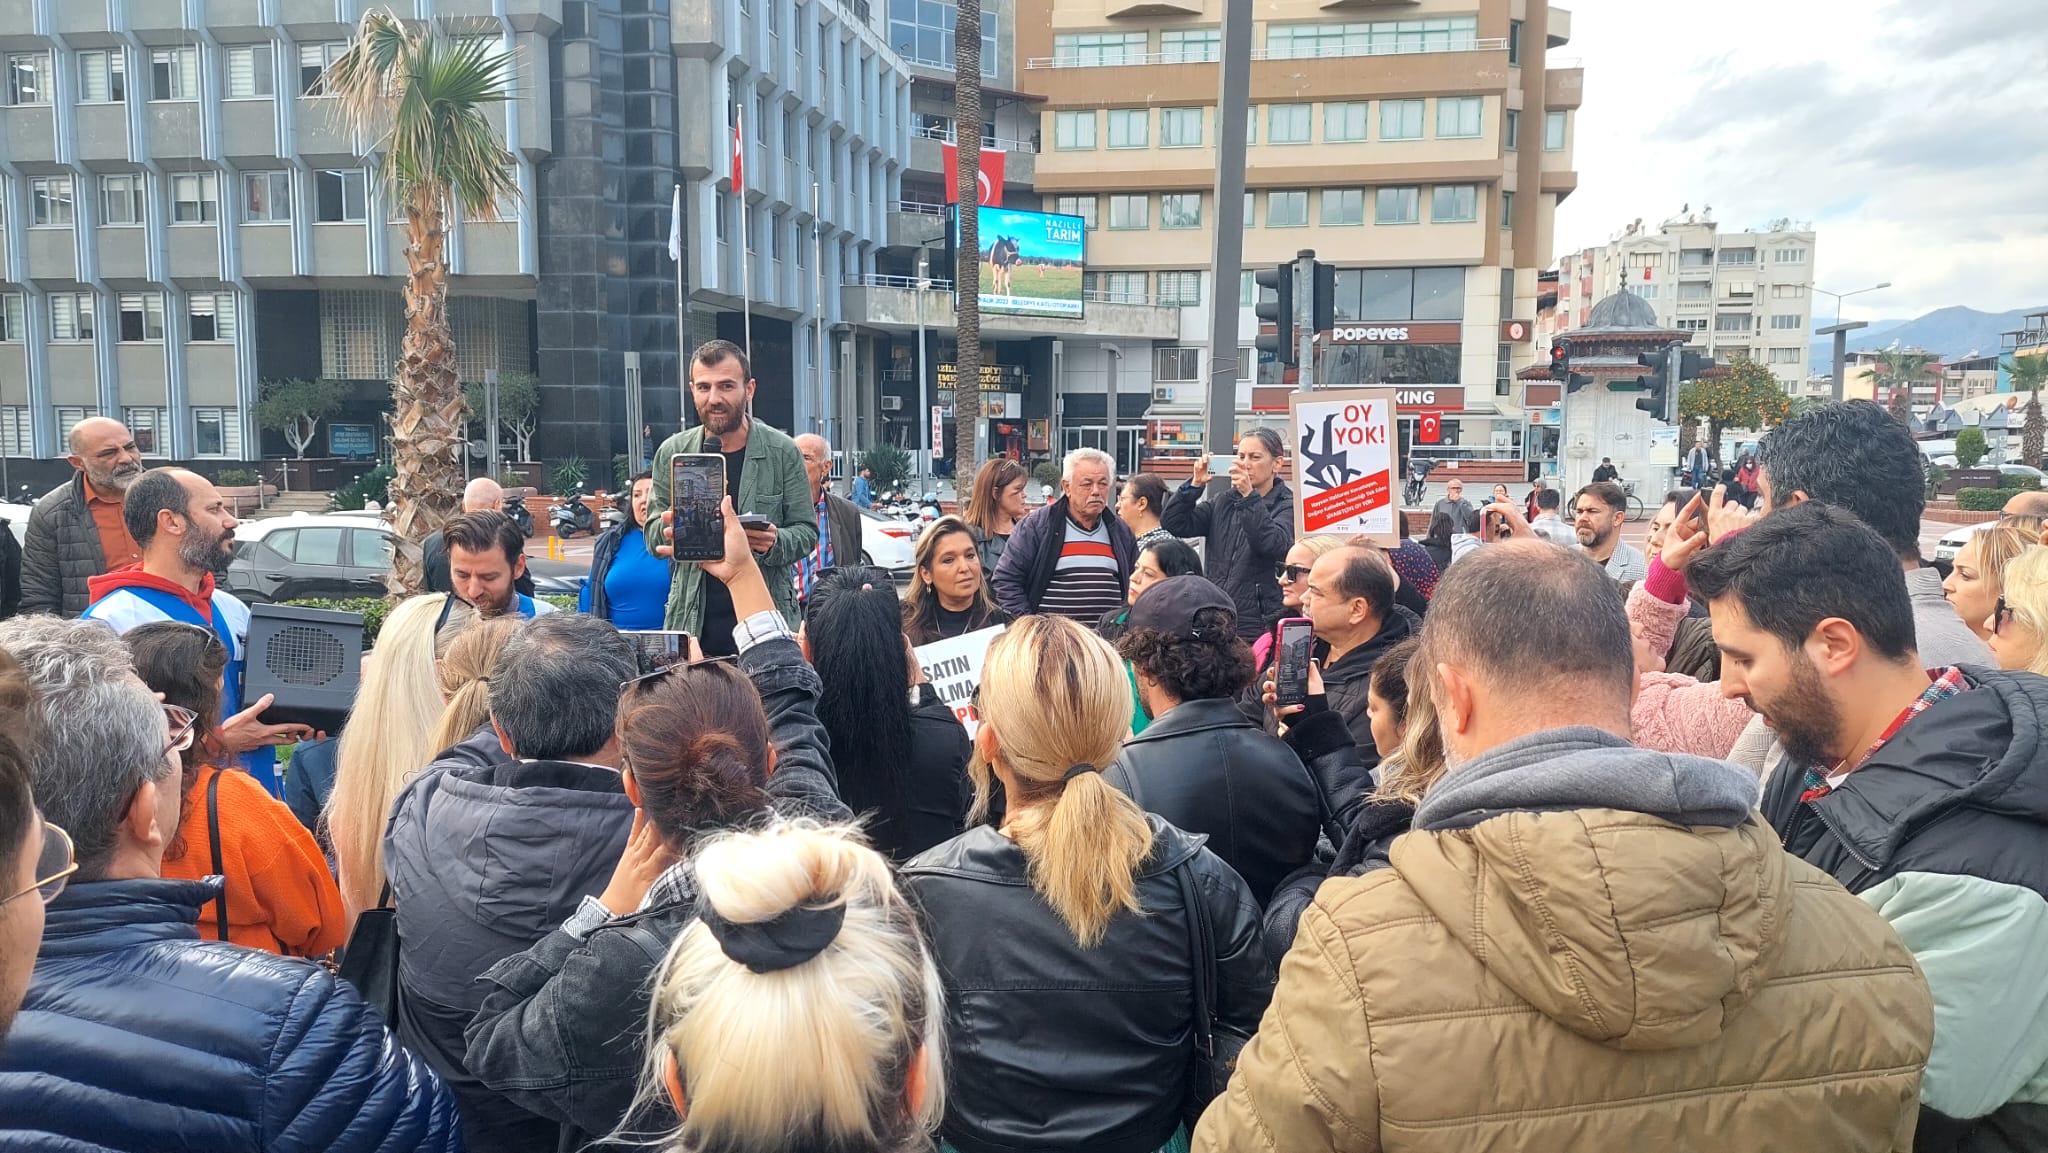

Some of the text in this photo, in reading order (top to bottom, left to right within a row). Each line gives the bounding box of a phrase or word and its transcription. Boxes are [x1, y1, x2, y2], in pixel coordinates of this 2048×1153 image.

[1046, 227, 1081, 242] TARIM
[1344, 404, 1372, 423] OY
[1335, 425, 1385, 445] YOK!
[922, 655, 970, 682] SATIN
[939, 679, 974, 703] LMA
